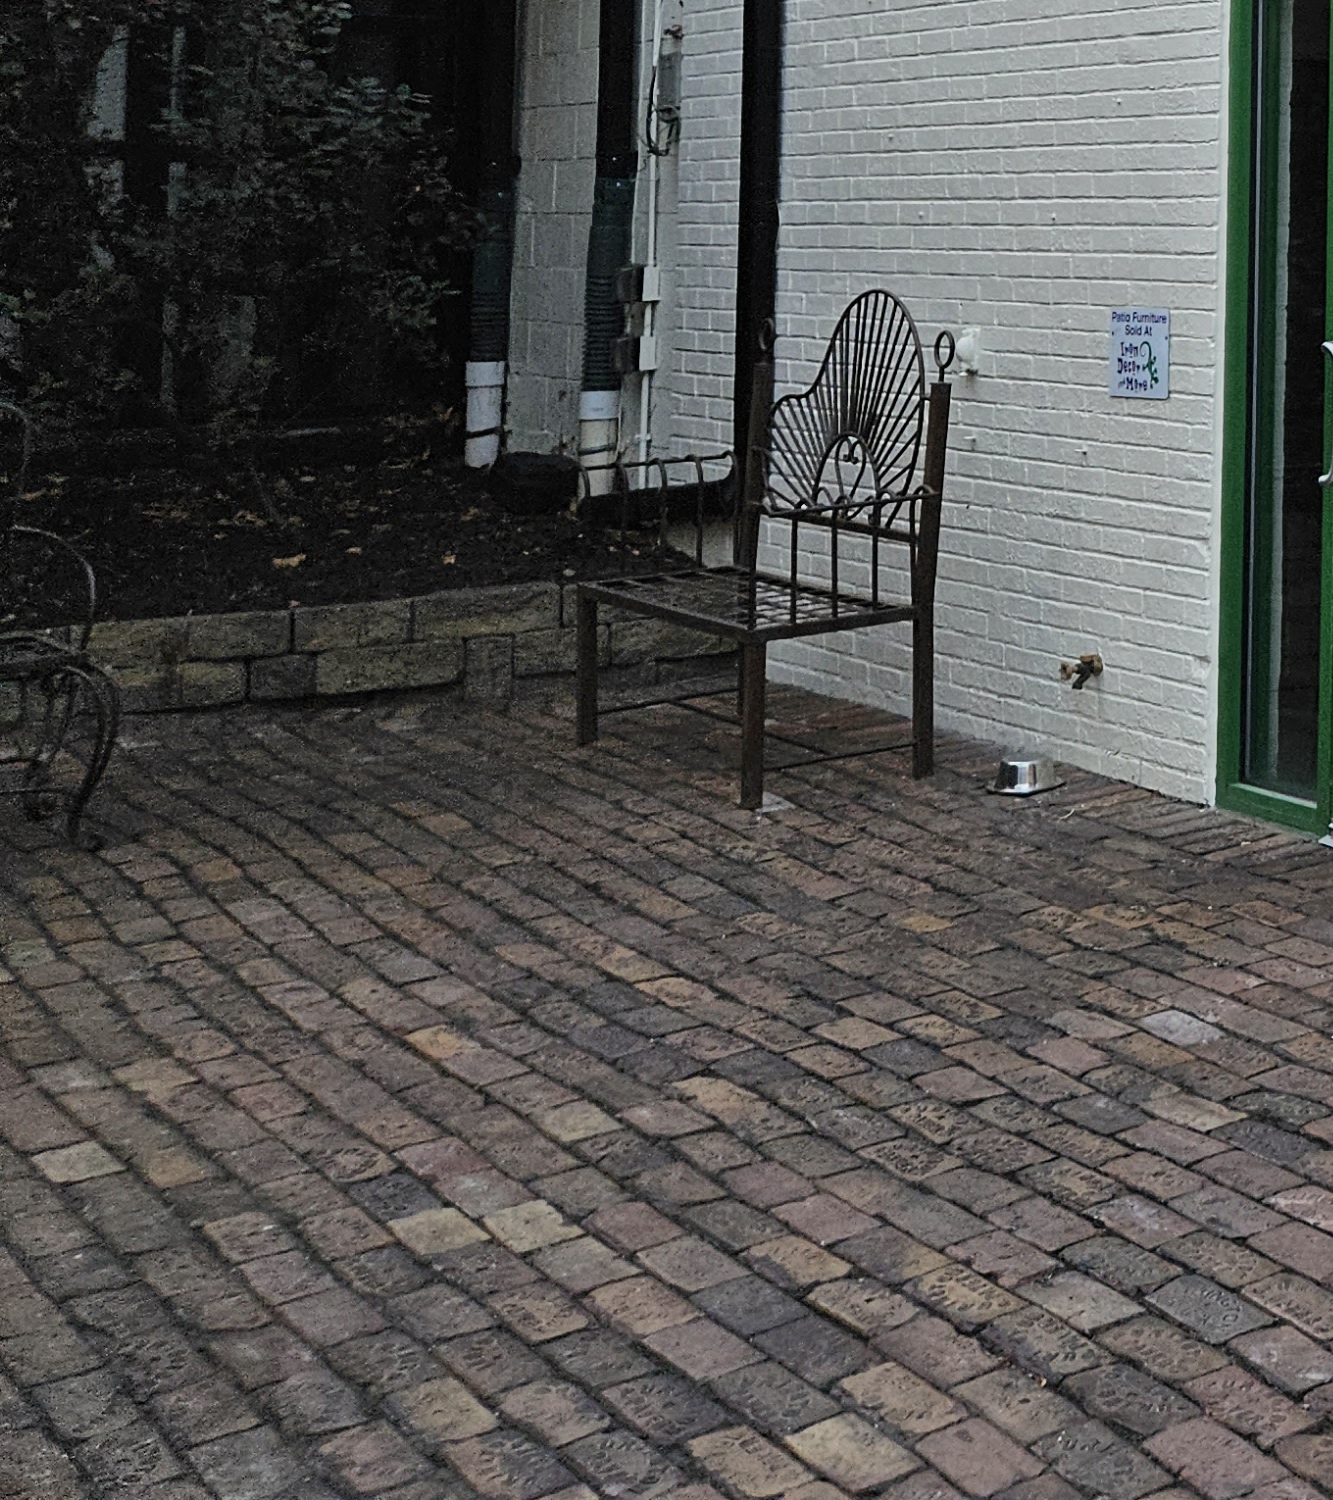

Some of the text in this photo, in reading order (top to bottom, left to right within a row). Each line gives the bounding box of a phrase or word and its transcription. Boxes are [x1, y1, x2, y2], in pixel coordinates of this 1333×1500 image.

[1111, 311, 1167, 324] Patio Furniture
[1125, 325, 1152, 336] Sold At
[1120, 341, 1139, 357] Iron
